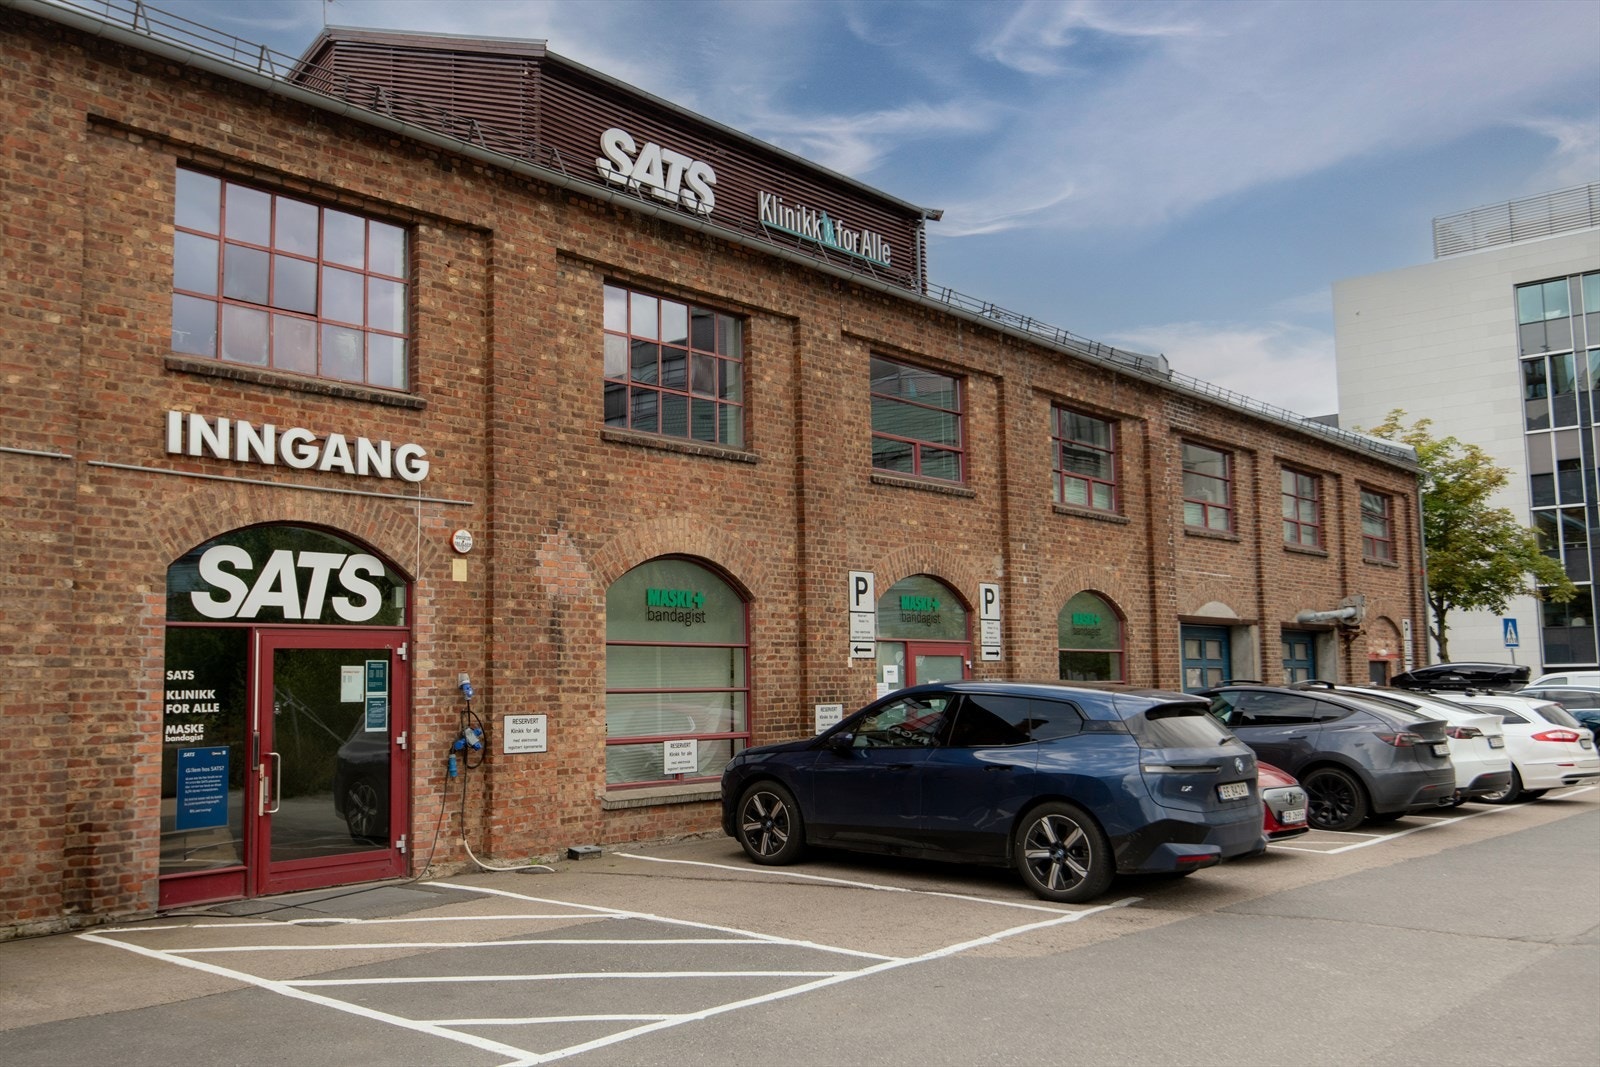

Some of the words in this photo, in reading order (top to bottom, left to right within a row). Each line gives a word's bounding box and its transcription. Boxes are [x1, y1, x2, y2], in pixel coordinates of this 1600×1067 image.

[595, 128, 717, 215] SATS
[758, 190, 822, 241] Klinikk
[835, 219, 860, 252] for
[861, 229, 892, 264] Alle
[166, 410, 430, 482] INNGANG
[190, 544, 386, 622] SATS
[855, 576, 869, 607] P
[984, 588, 995, 615] P
[647, 606, 707, 627] bandagist
[901, 611, 942, 627] bandagist
[166, 670, 195, 681] SATS
[166, 689, 216, 700] KLINIKK
[165, 703, 190, 714] FOR
[192, 702, 220, 713] ALLE
[164, 733, 204, 743] bandagist
[165, 724, 204, 735] MASKE
